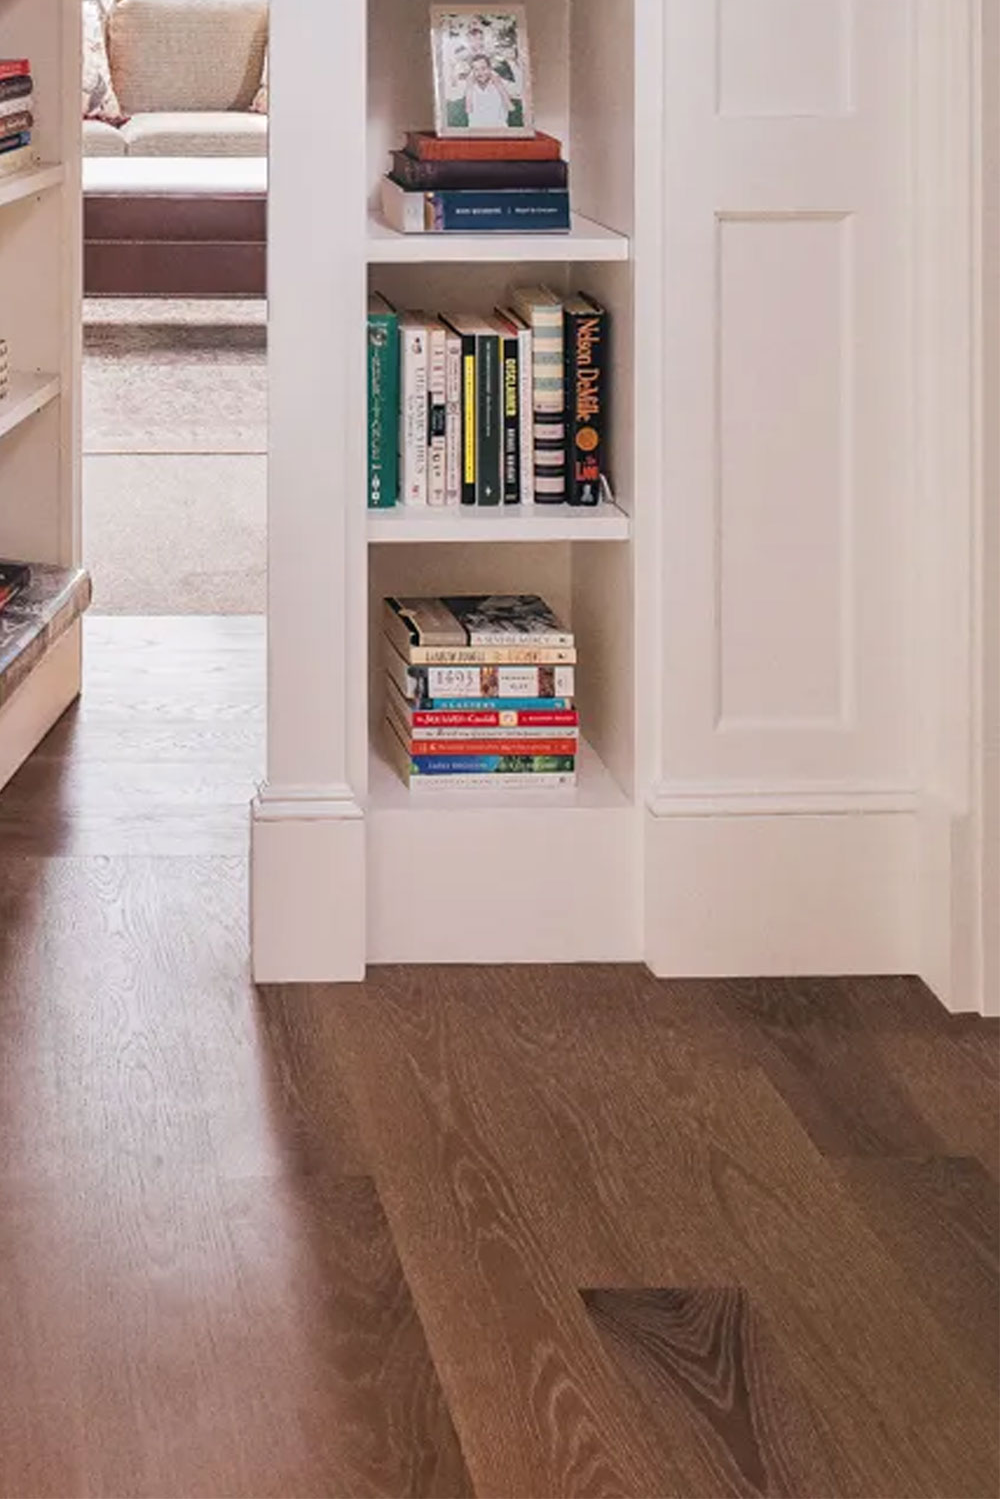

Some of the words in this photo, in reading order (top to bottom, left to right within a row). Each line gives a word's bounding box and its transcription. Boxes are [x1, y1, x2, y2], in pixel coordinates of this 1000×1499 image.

[576, 318, 600, 365] Nelson
[505, 358, 516, 417] DISCLAIMER
[576, 368, 600, 423] DeMille
